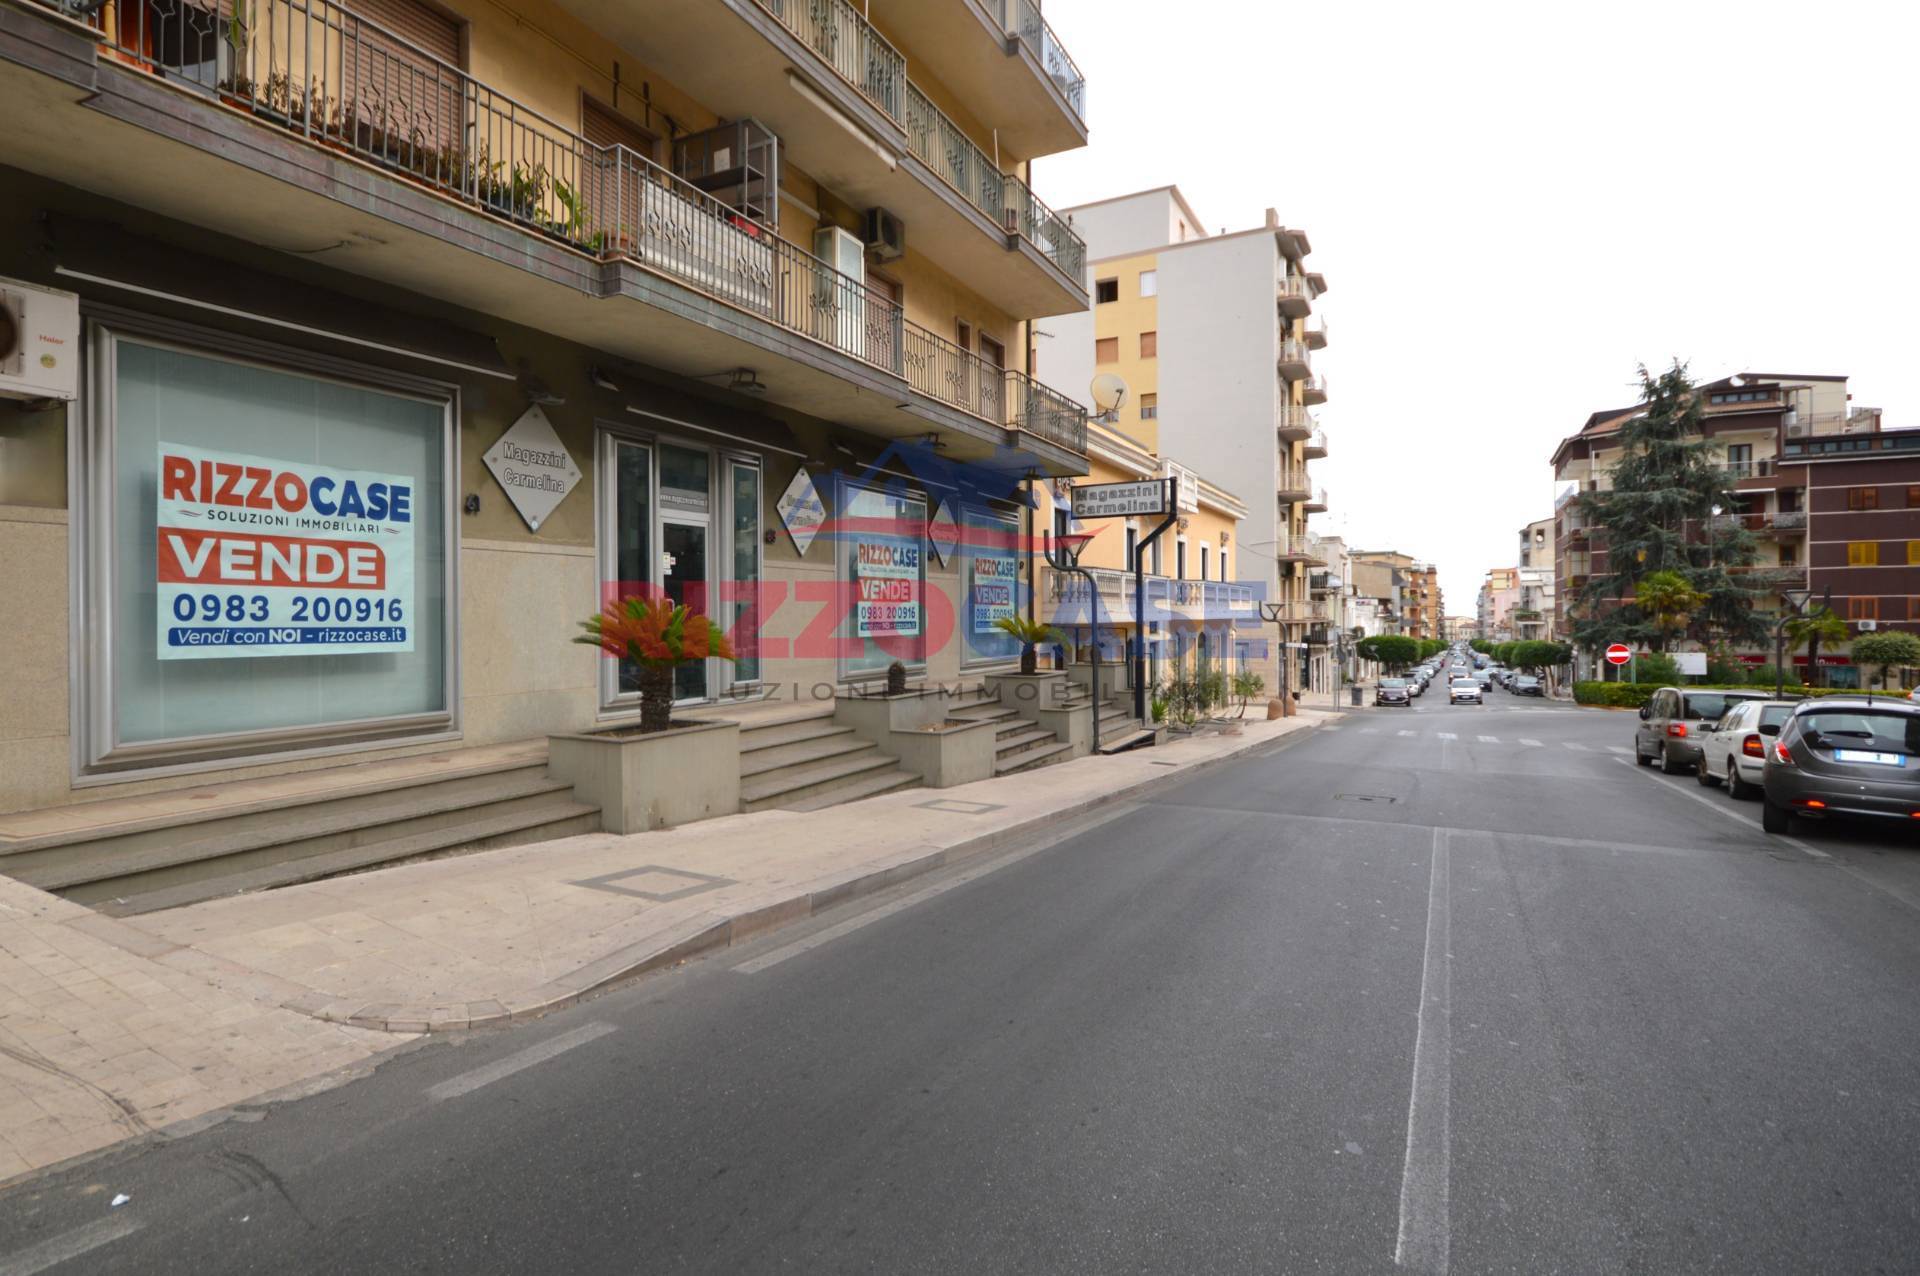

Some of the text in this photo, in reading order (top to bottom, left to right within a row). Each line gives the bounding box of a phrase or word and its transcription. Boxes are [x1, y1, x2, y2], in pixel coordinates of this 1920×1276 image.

[503, 441, 566, 469] Magazzini
[162, 455, 411, 523] RIZZOCASE
[503, 468, 565, 493] Carmelina
[1075, 484, 1158, 502] Magazzini
[1075, 500, 1159, 515] Carmelina
[208, 509, 380, 534] SOLUZIONI IMMOBILIARI
[167, 534, 378, 585] VENDE
[859, 543, 918, 568] RIZZOCASE
[975, 557, 1014, 577] RIZZOCASE
[860, 579, 909, 600] VENDE
[976, 586, 1009, 604] VENDE
[172, 593, 403, 622] 0983 200916
[861, 606, 916, 620] 0983 200916
[178, 629, 230, 644] Vendi
[233, 632, 266, 644] con
[268, 629, 301, 643] NOI
[318, 627, 402, 643] rizzocase.it
